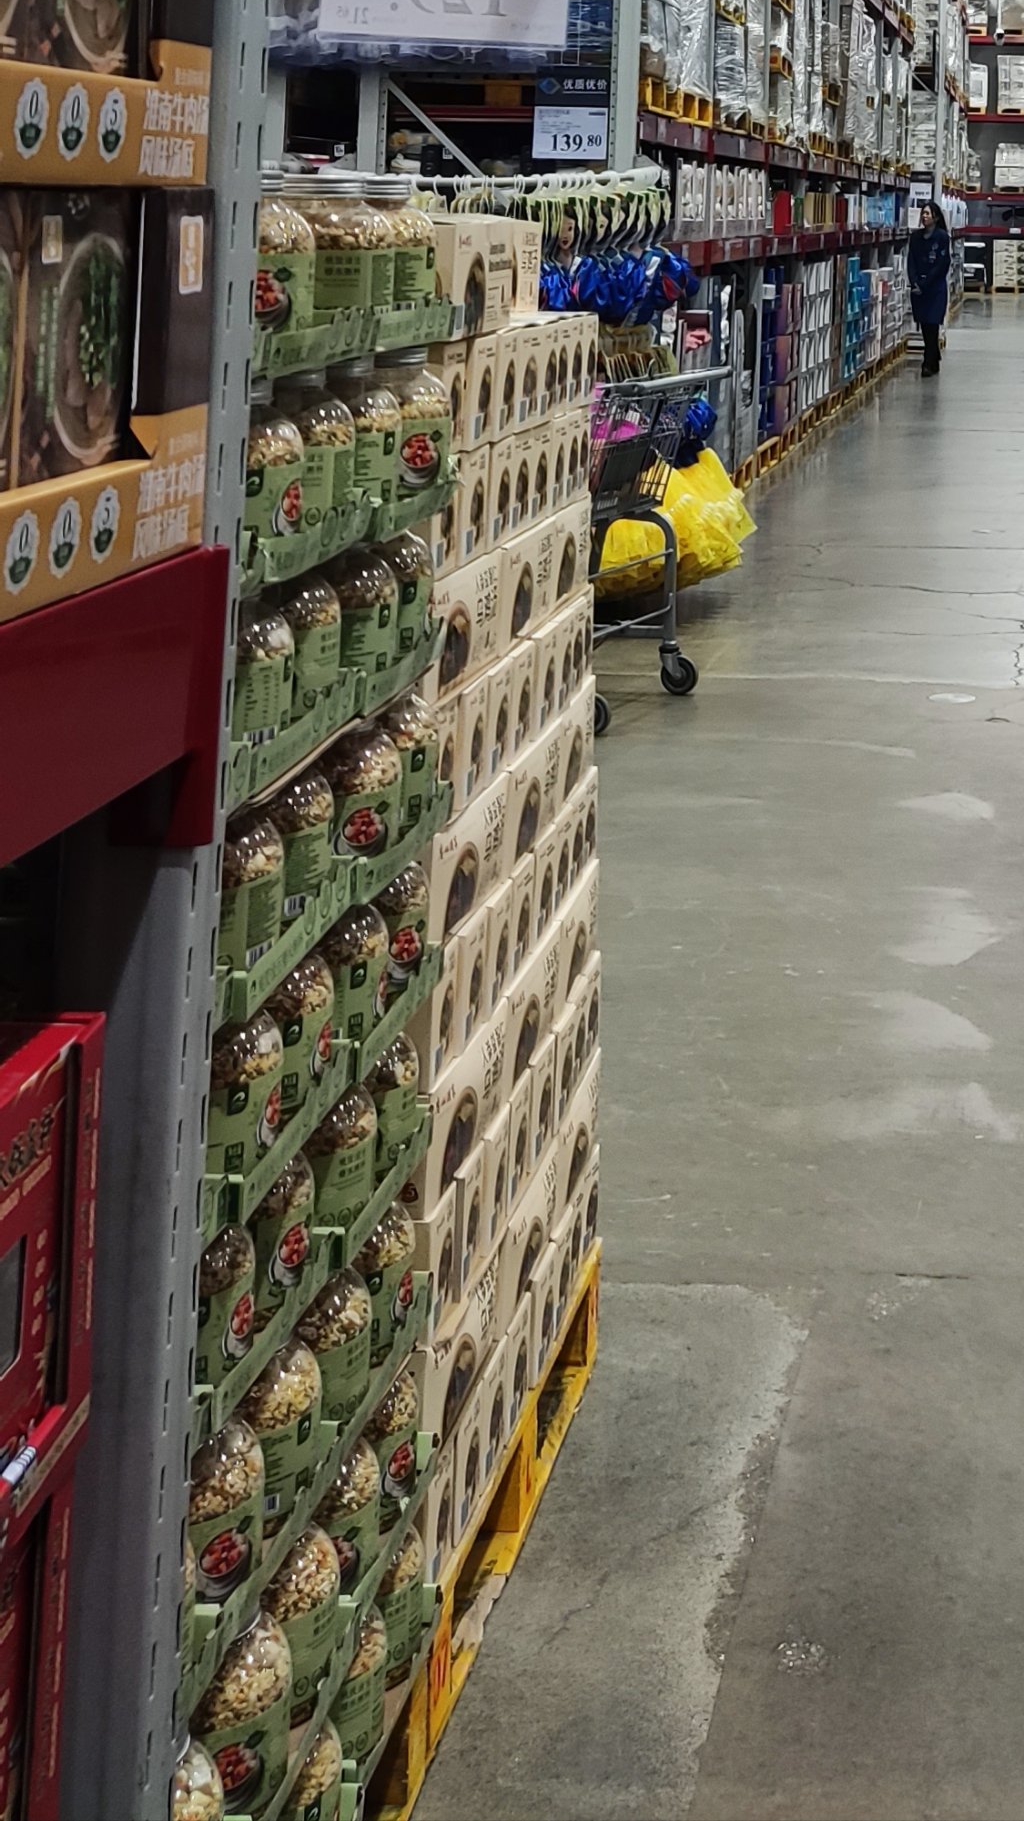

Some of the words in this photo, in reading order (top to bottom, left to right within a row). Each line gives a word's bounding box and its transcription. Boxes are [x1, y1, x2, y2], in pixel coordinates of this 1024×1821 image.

[563, 78, 607, 90] 优质优价
[551, 133, 602, 153] 139.80
